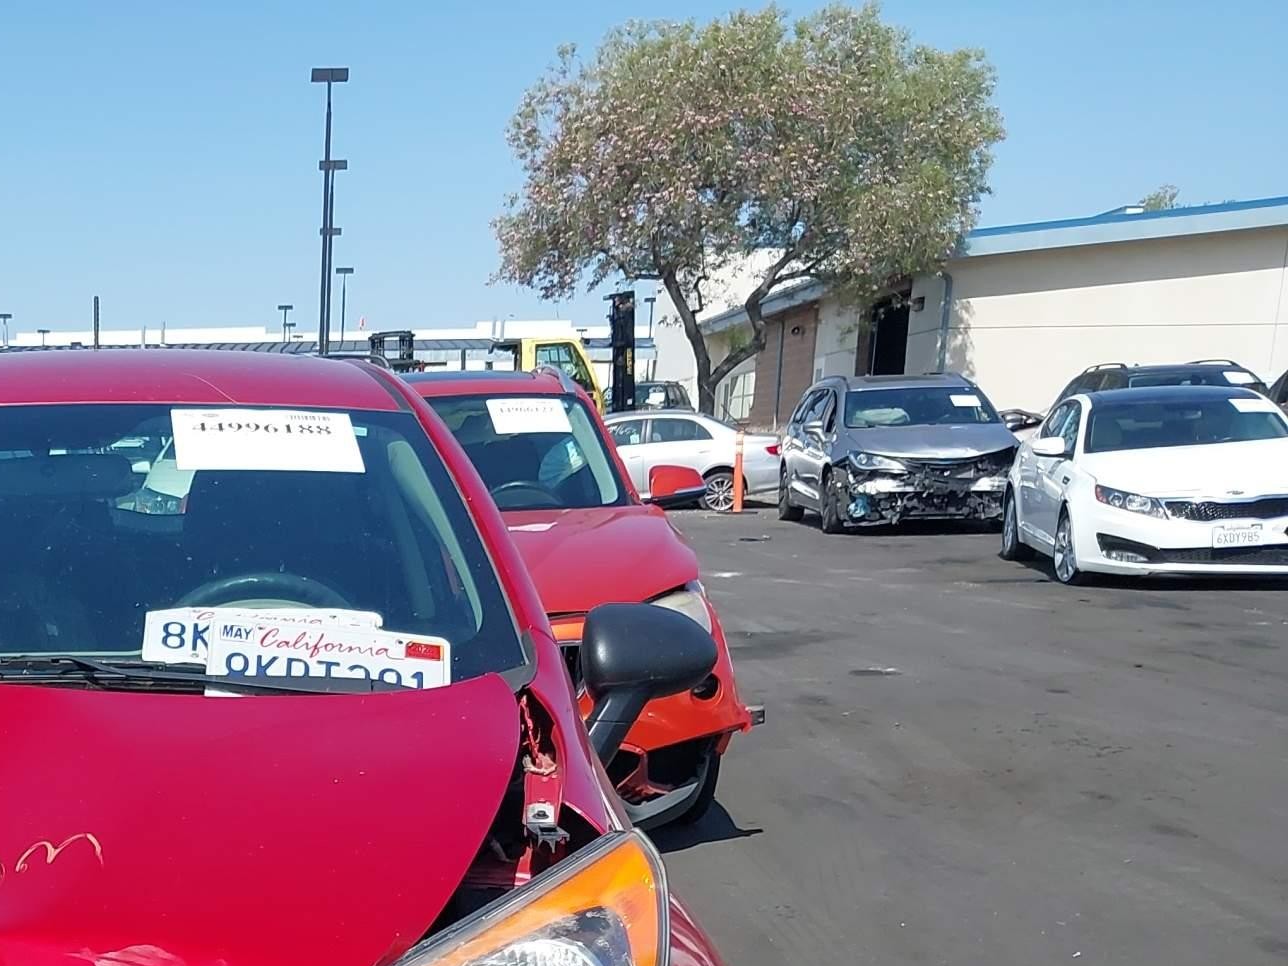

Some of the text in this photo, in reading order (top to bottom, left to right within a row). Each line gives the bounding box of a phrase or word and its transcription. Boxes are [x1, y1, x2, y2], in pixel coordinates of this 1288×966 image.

[192, 422, 332, 435] 44996188
[222, 624, 254, 640] MAY
[259, 628, 405, 660] California
